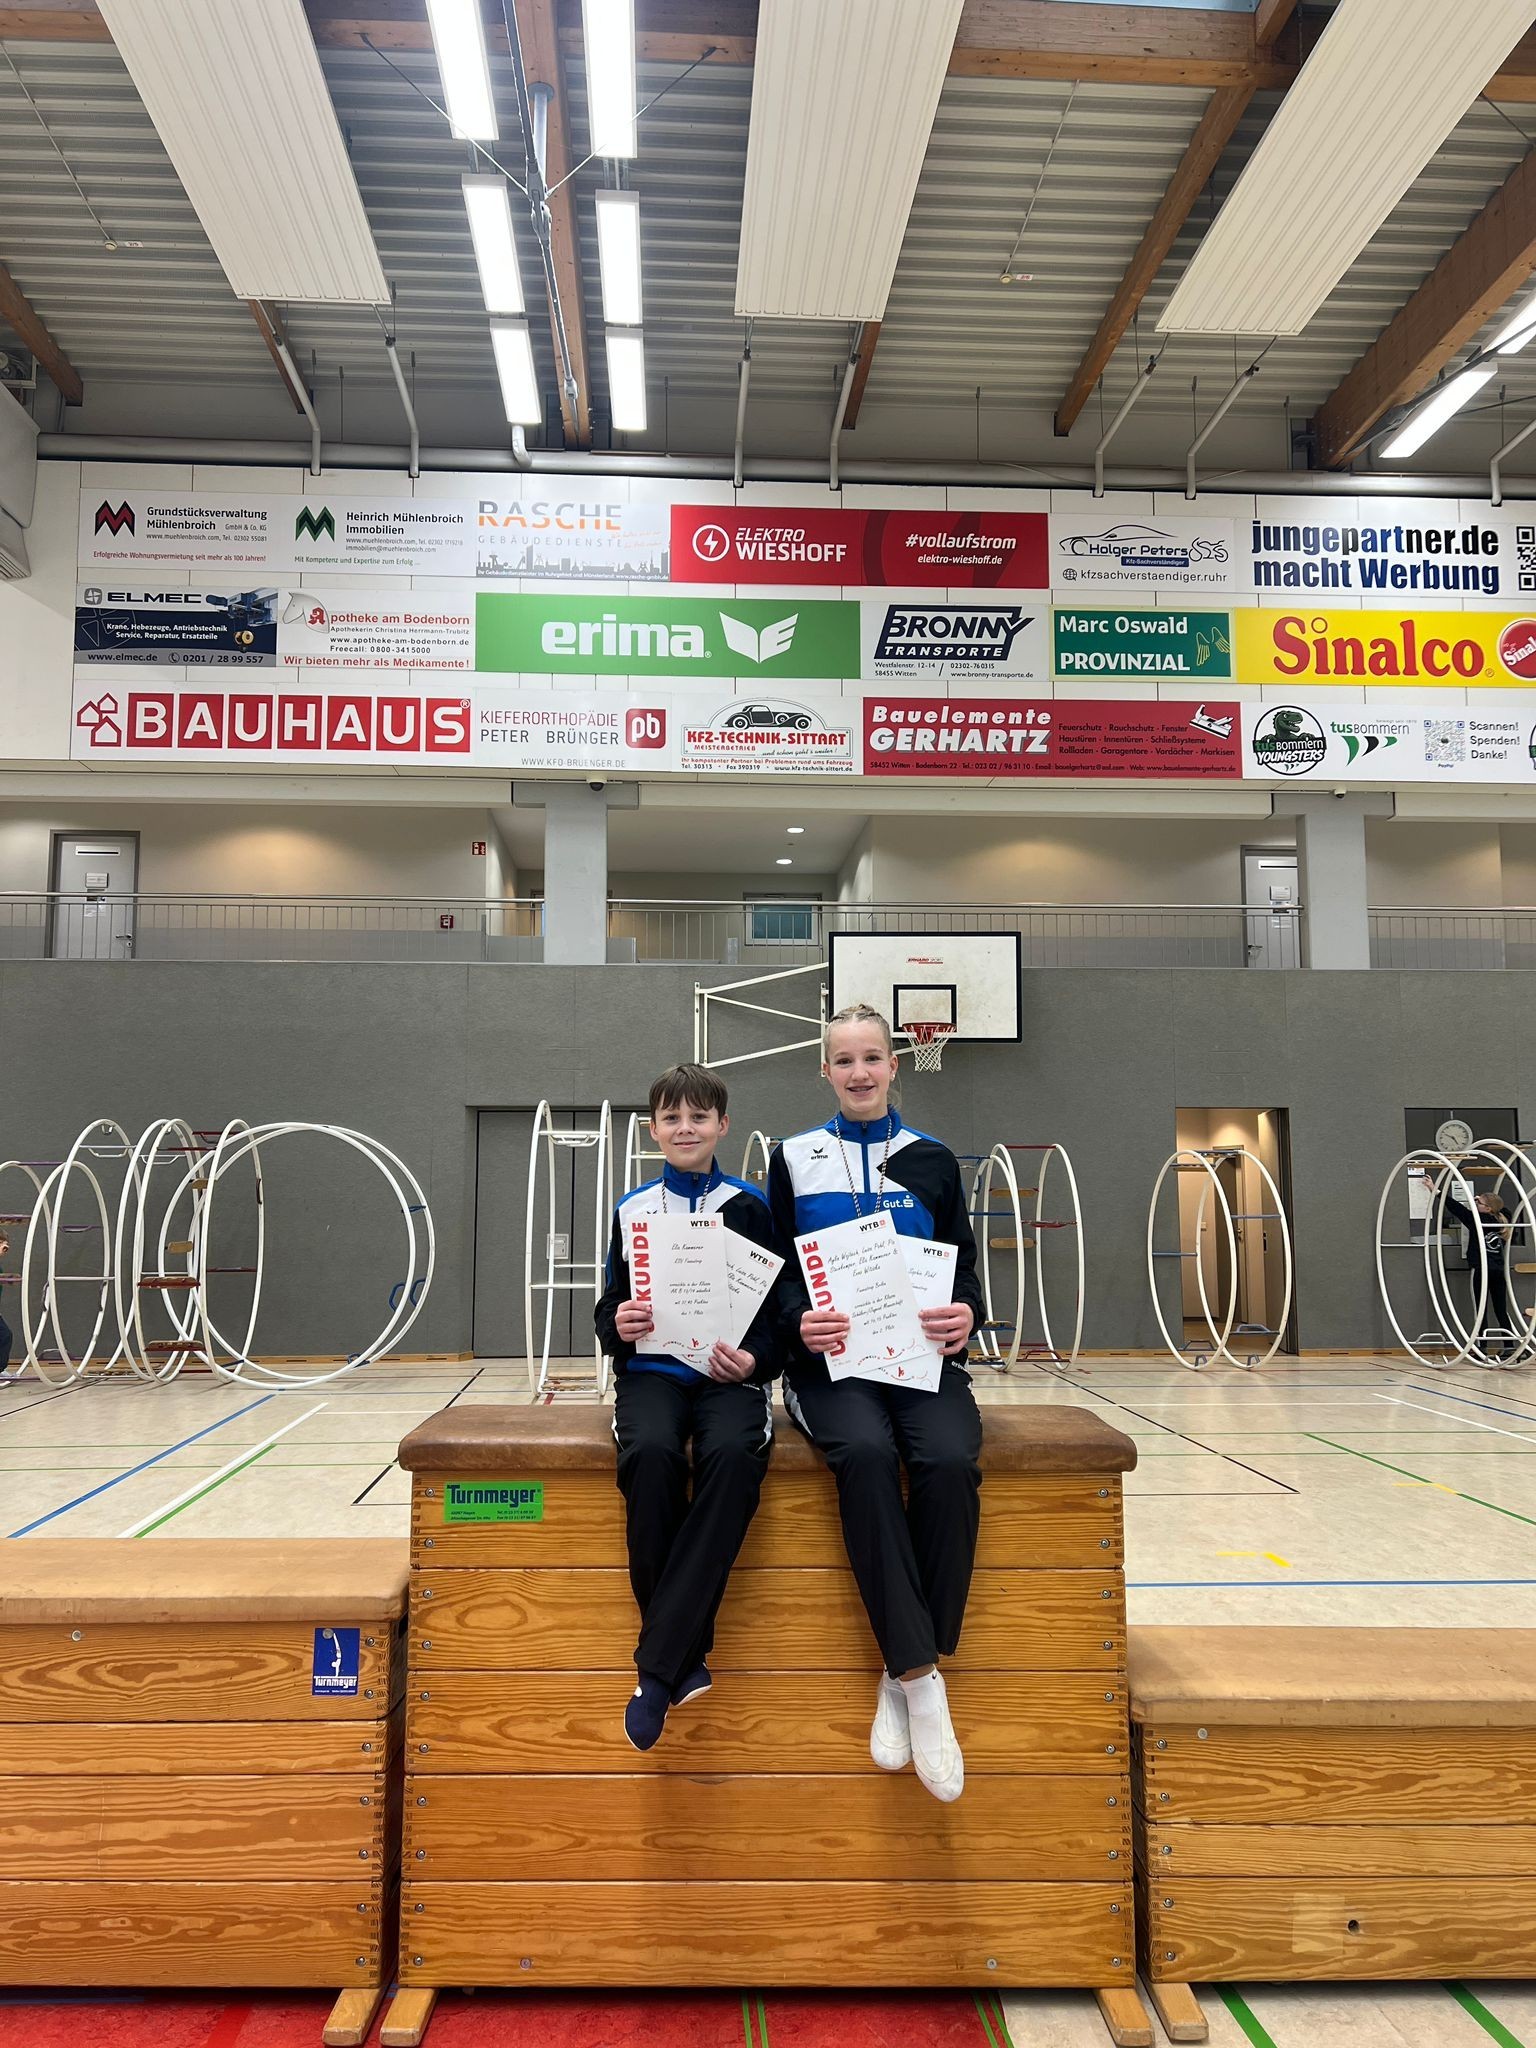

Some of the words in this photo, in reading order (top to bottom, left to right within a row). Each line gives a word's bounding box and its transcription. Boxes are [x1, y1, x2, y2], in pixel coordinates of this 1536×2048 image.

[147, 506, 267, 520] Grundstücksverwaltung
[347, 512, 389, 522] Heinrich
[393, 513, 463, 523] Mühlenbroich
[478, 500, 621, 530] RASCHE
[147, 520, 216, 530] Mühlenbroich
[346, 525, 404, 534] Immobilien
[736, 526, 805, 542] ELEKTRO
[1252, 520, 1499, 556] jungepartner.de
[478, 534, 622, 548] GEBÄUDEDIENSTE
[906, 533, 1017, 550] #vollaufstrom
[94, 551, 128, 559] Erfolgreiche
[130, 552, 194, 561] Wohnungsvermietung
[736, 542, 847, 562] WIESHOFF
[1089, 544, 1136, 557] Holger
[1140, 544, 1188, 556] Peters
[306, 556, 338, 564] Kompetenz
[354, 557, 380, 565] Expertise
[396, 558, 413, 566] Erfolg
[917, 554, 1002, 565] elektro-wieshoff.de
[1126, 558, 1185, 566] Kfz-Sachverständiger
[1081, 570, 1227, 583] kfzsachverstaendiger.ruhr
[1254, 558, 1352, 587] macht
[1358, 559, 1500, 594] Werbung
[108, 592, 202, 604] ELMEC
[404, 614, 470, 625] Bodenborn
[1060, 616, 1108, 633] Marc
[1114, 616, 1188, 634] Oswald
[106, 623, 130, 631] Krane,
[131, 624, 171, 632] Hebezeuge,
[173, 624, 228, 632] Antriebstechnik
[888, 615, 1036, 643] BRONNY
[144, 632, 180, 640] Reparatur,
[330, 637, 469, 646] www.apotheke-am-bodenborn.de
[541, 613, 704, 658] erima
[884, 646, 1003, 657] TRANSPORTE
[1273, 616, 1484, 678] Sinalco
[88, 654, 157, 662] www.elmec.de
[183, 654, 206, 663] 0201
[217, 655, 229, 663] 28
[231, 655, 243, 663] 99
[246, 656, 263, 664] 557
[284, 656, 302, 665] Wir
[306, 656, 339, 666] bieten
[342, 657, 370, 666] mehr
[374, 658, 389, 667] als
[1061, 652, 1190, 671] PROVINZIAL
[480, 710, 618, 727] KIEFERORTHOPÄDIE
[872, 706, 1051, 724] Bauelemente
[133, 700, 467, 747] BAUHAUS
[631, 713, 660, 742] pb
[1059, 724, 1102, 732] Feuerschutz
[1109, 724, 1154, 732] Rauchschutz
[1470, 721, 1519, 731] Scannen!
[480, 730, 529, 743] PETER
[546, 728, 619, 744] BRÜNGER
[687, 731, 846, 745] KFZ-TECHNIK-SITTART
[869, 728, 1050, 753] GERHARTZ
[1059, 735, 1096, 743] Haustüren
[1151, 736, 1206, 745] Schließsysteme
[1470, 735, 1520, 746] Spenden!
[1101, 747, 1148, 756] Garagentore
[1155, 747, 1194, 755] Vordächer
[1201, 748, 1235, 756] Markisen
[1258, 750, 1324, 764] YOUNGSTERS
[1471, 750, 1507, 759] Danke!
[860, 1222, 879, 1231] WTB
[750, 1250, 768, 1264] WTB
[923, 1247, 942, 1256] WTB
[447, 1485, 536, 1508] Turnmeyer
[314, 1676, 357, 1688] Turnmeyer
